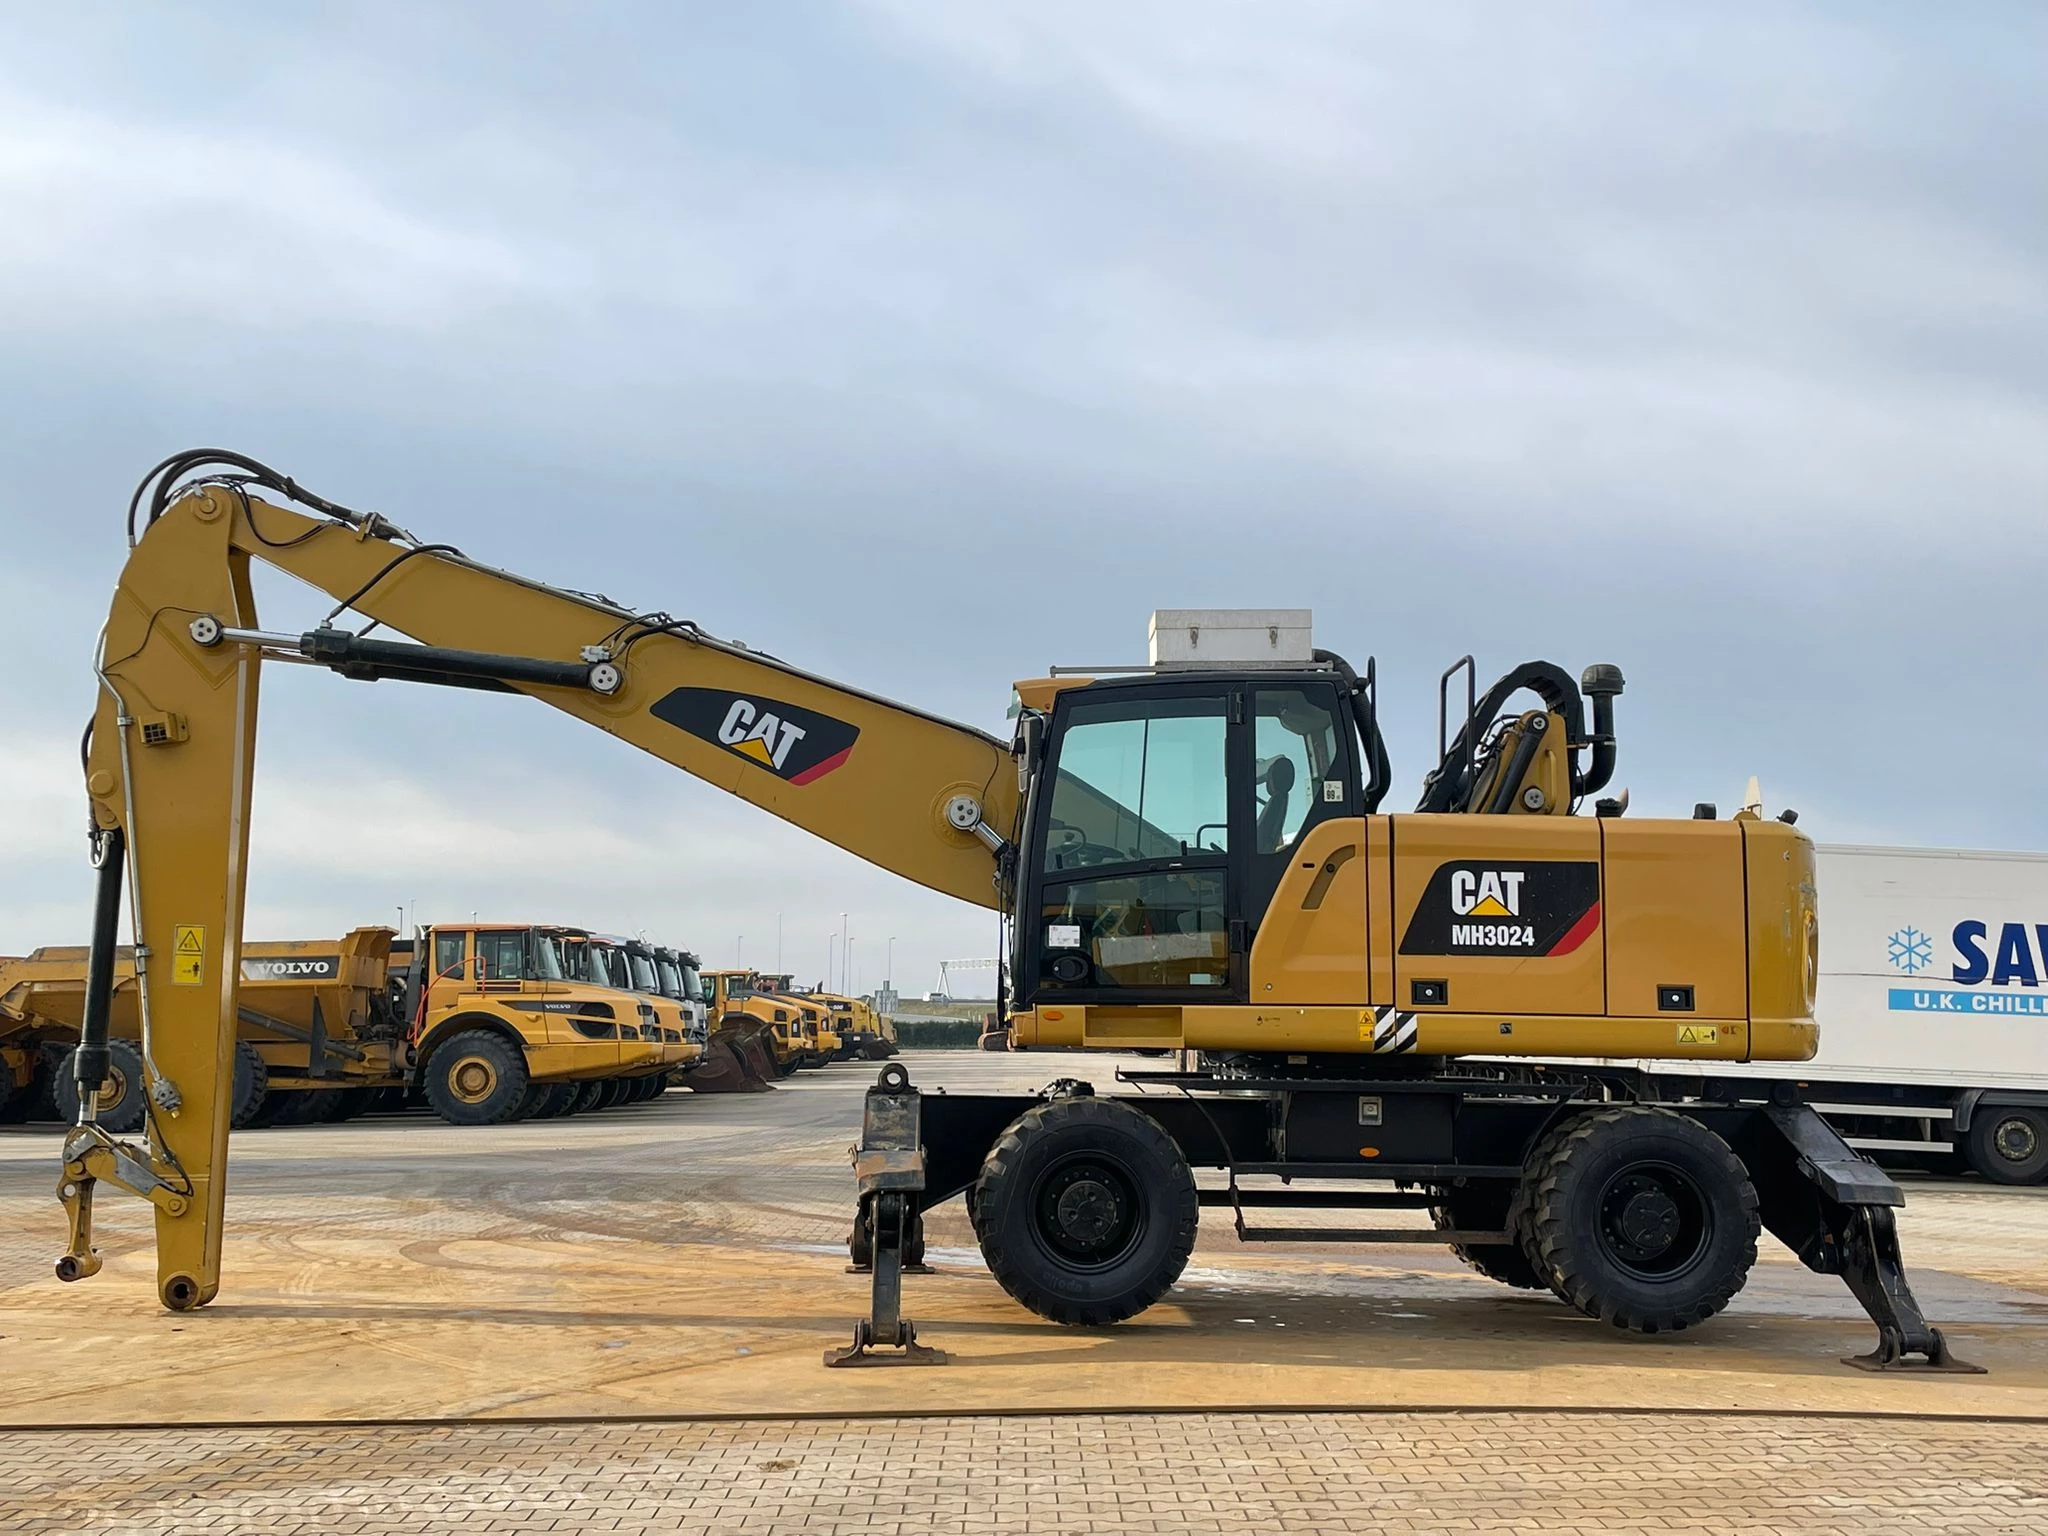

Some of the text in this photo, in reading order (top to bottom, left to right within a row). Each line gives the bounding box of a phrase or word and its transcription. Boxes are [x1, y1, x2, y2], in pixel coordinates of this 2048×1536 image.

[718, 699, 807, 770] CAT
[1451, 869, 1525, 917] CAT
[1452, 924, 1535, 947] MH3024
[254, 961, 330, 975] VOLVO
[1913, 992, 1962, 1011] U.K.
